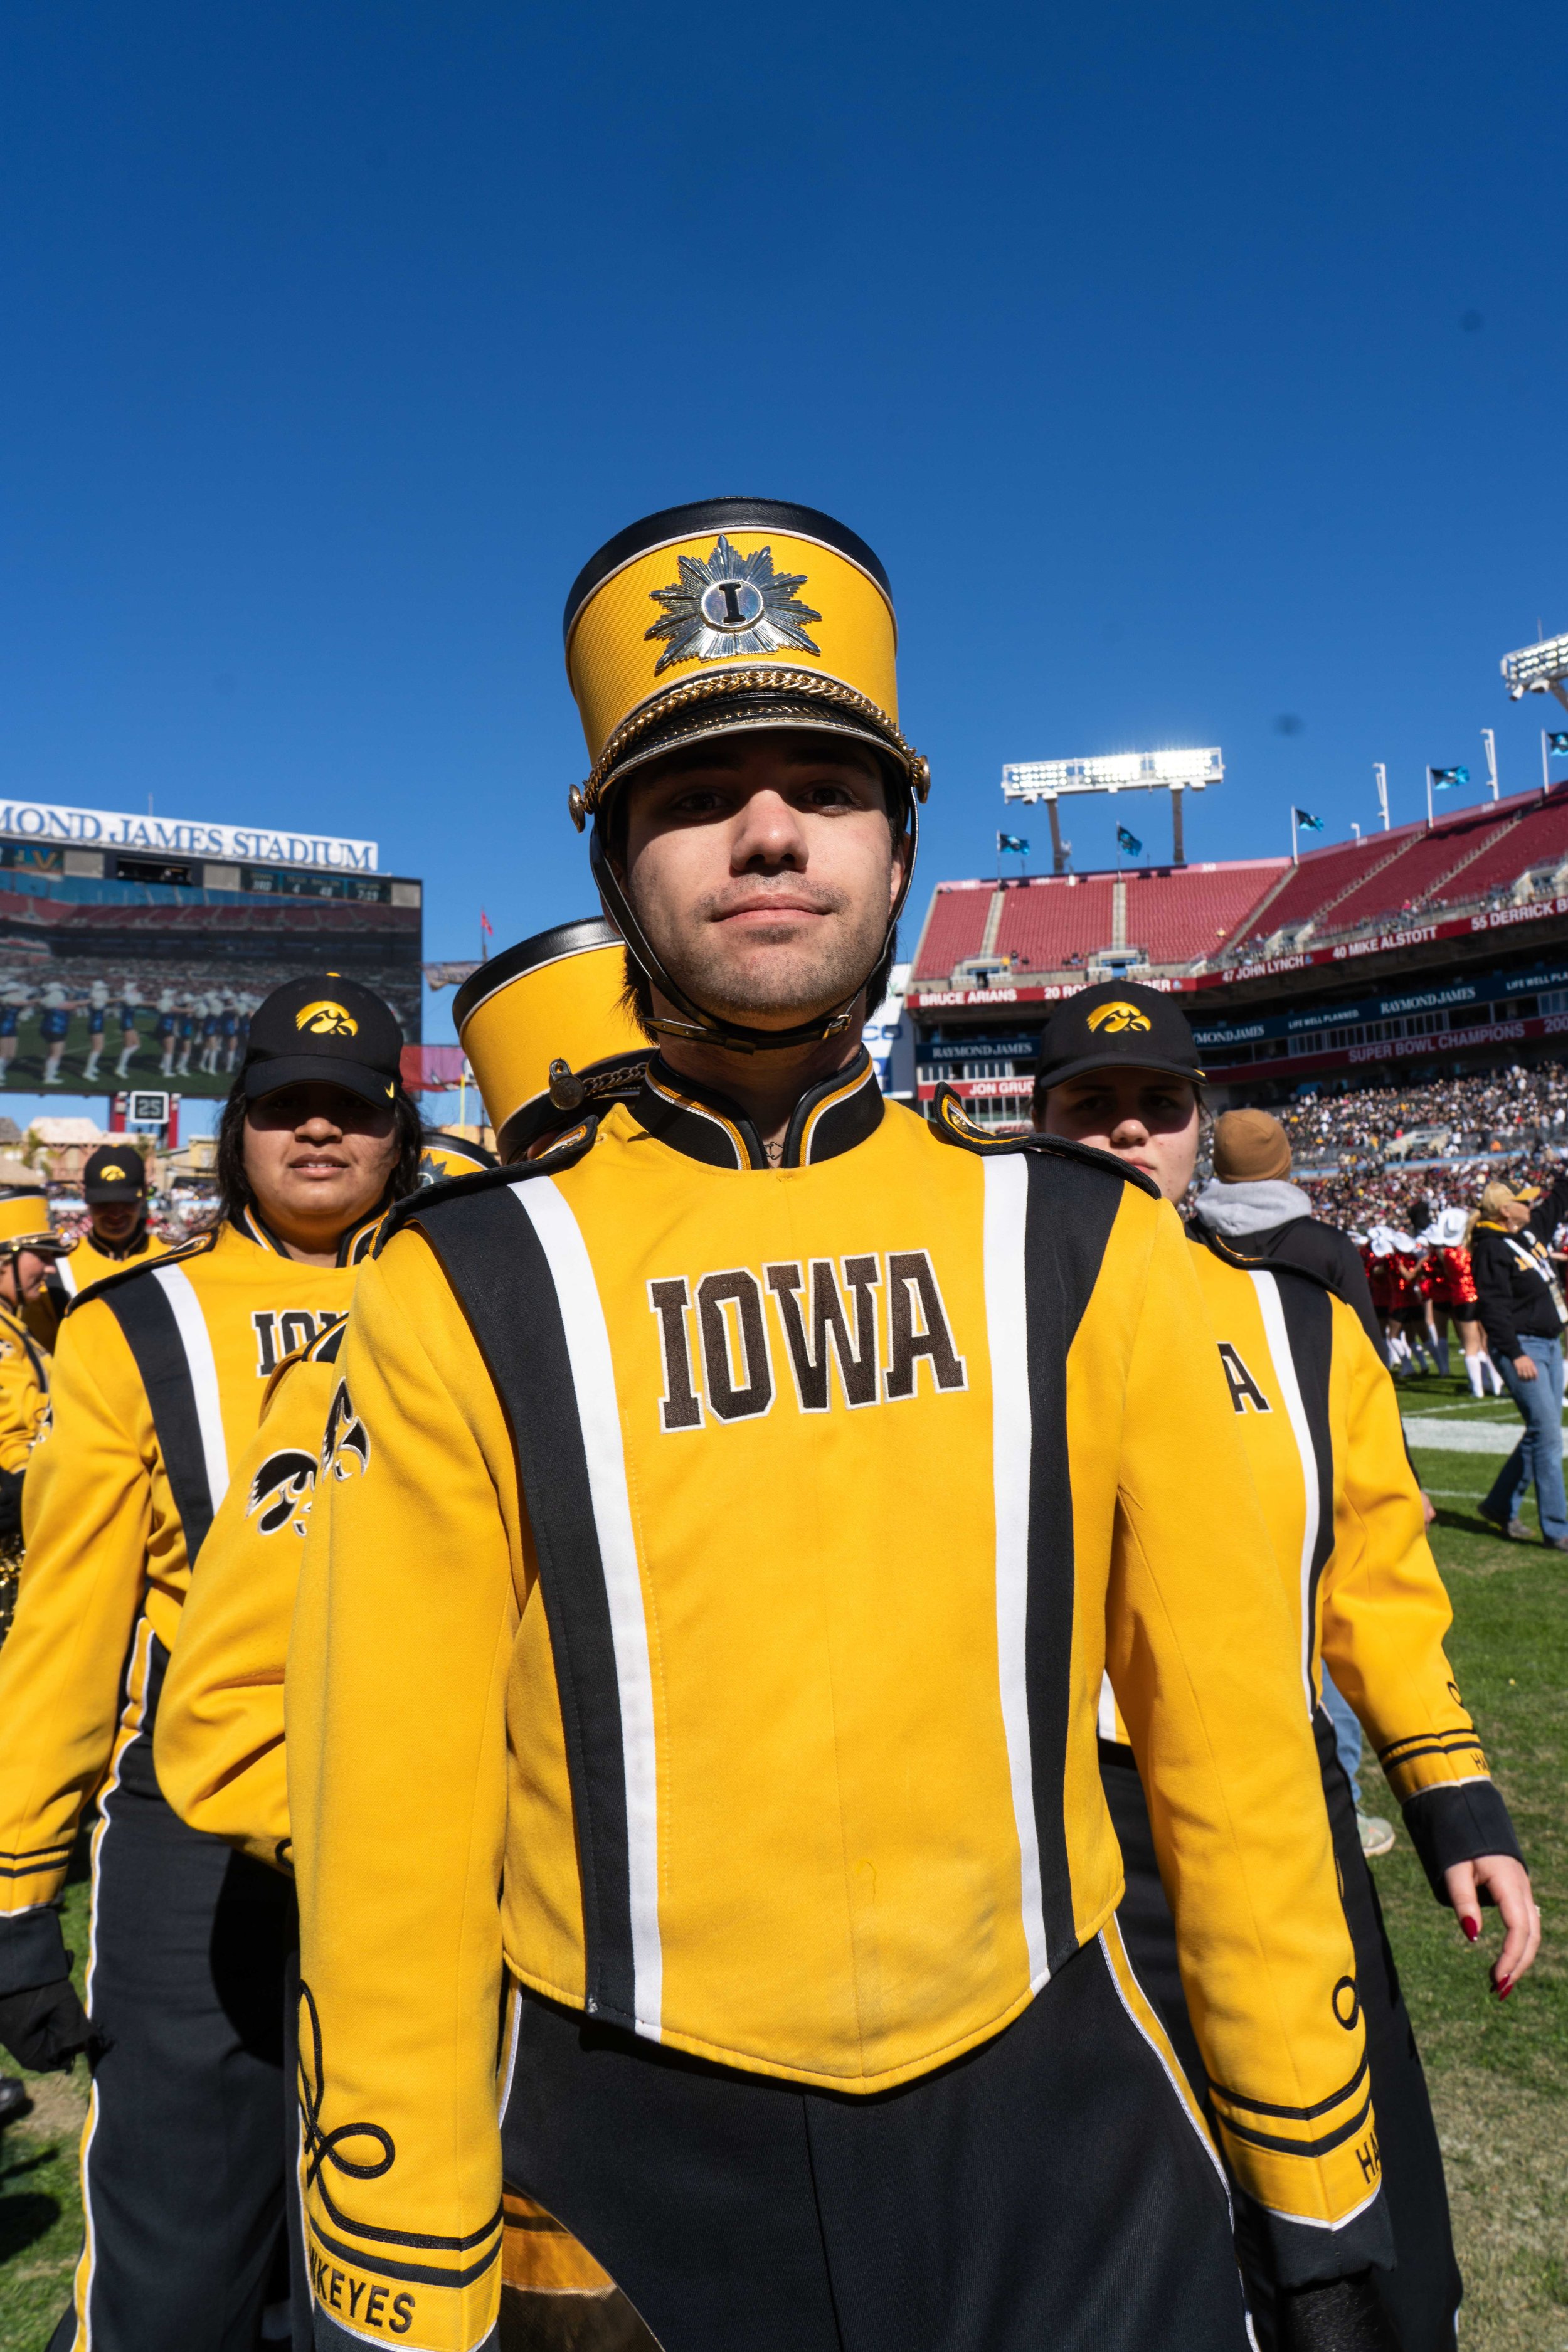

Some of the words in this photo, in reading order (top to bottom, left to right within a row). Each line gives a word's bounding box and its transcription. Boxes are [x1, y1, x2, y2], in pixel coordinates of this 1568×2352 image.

[719, 582, 746, 623] I
[109, 818, 223, 854] JAMES
[233, 832, 373, 871] STADIUM
[1471, 916, 1488, 931] 55
[1490, 901, 1554, 927] DERRICK
[1332, 945, 1347, 959] 40
[1348, 938, 1379, 956] MIKE
[1380, 925, 1438, 950] ALSTOTT
[1222, 970, 1234, 982] 47
[1236, 962, 1266, 981] JOHN
[1266, 955, 1304, 973] LYNCH
[1044, 986, 1061, 1000] 20
[1506, 980, 1525, 991] LIFE
[1526, 974, 1550, 987] WELL
[919, 991, 965, 1007] BRUCE
[967, 988, 1017, 1004] ARIANS
[1380, 993, 1437, 1015] RAYMOND
[1437, 986, 1476, 1004] JAMES
[1234, 1024, 1265, 1041] JAMES
[1288, 1019, 1303, 1029] LIFE
[1303, 1015, 1322, 1027] WELL
[932, 1044, 992, 1059] RAYMOND
[993, 1042, 1032, 1056] JAMES
[1349, 1044, 1392, 1063] SUPER
[1396, 1039, 1436, 1056] BOWL
[1438, 1022, 1526, 1049] CHAMPIONS
[969, 1082, 997, 1096] JON
[138, 1098, 161, 1116] 25
[645, 1248, 970, 1435] IOWA
